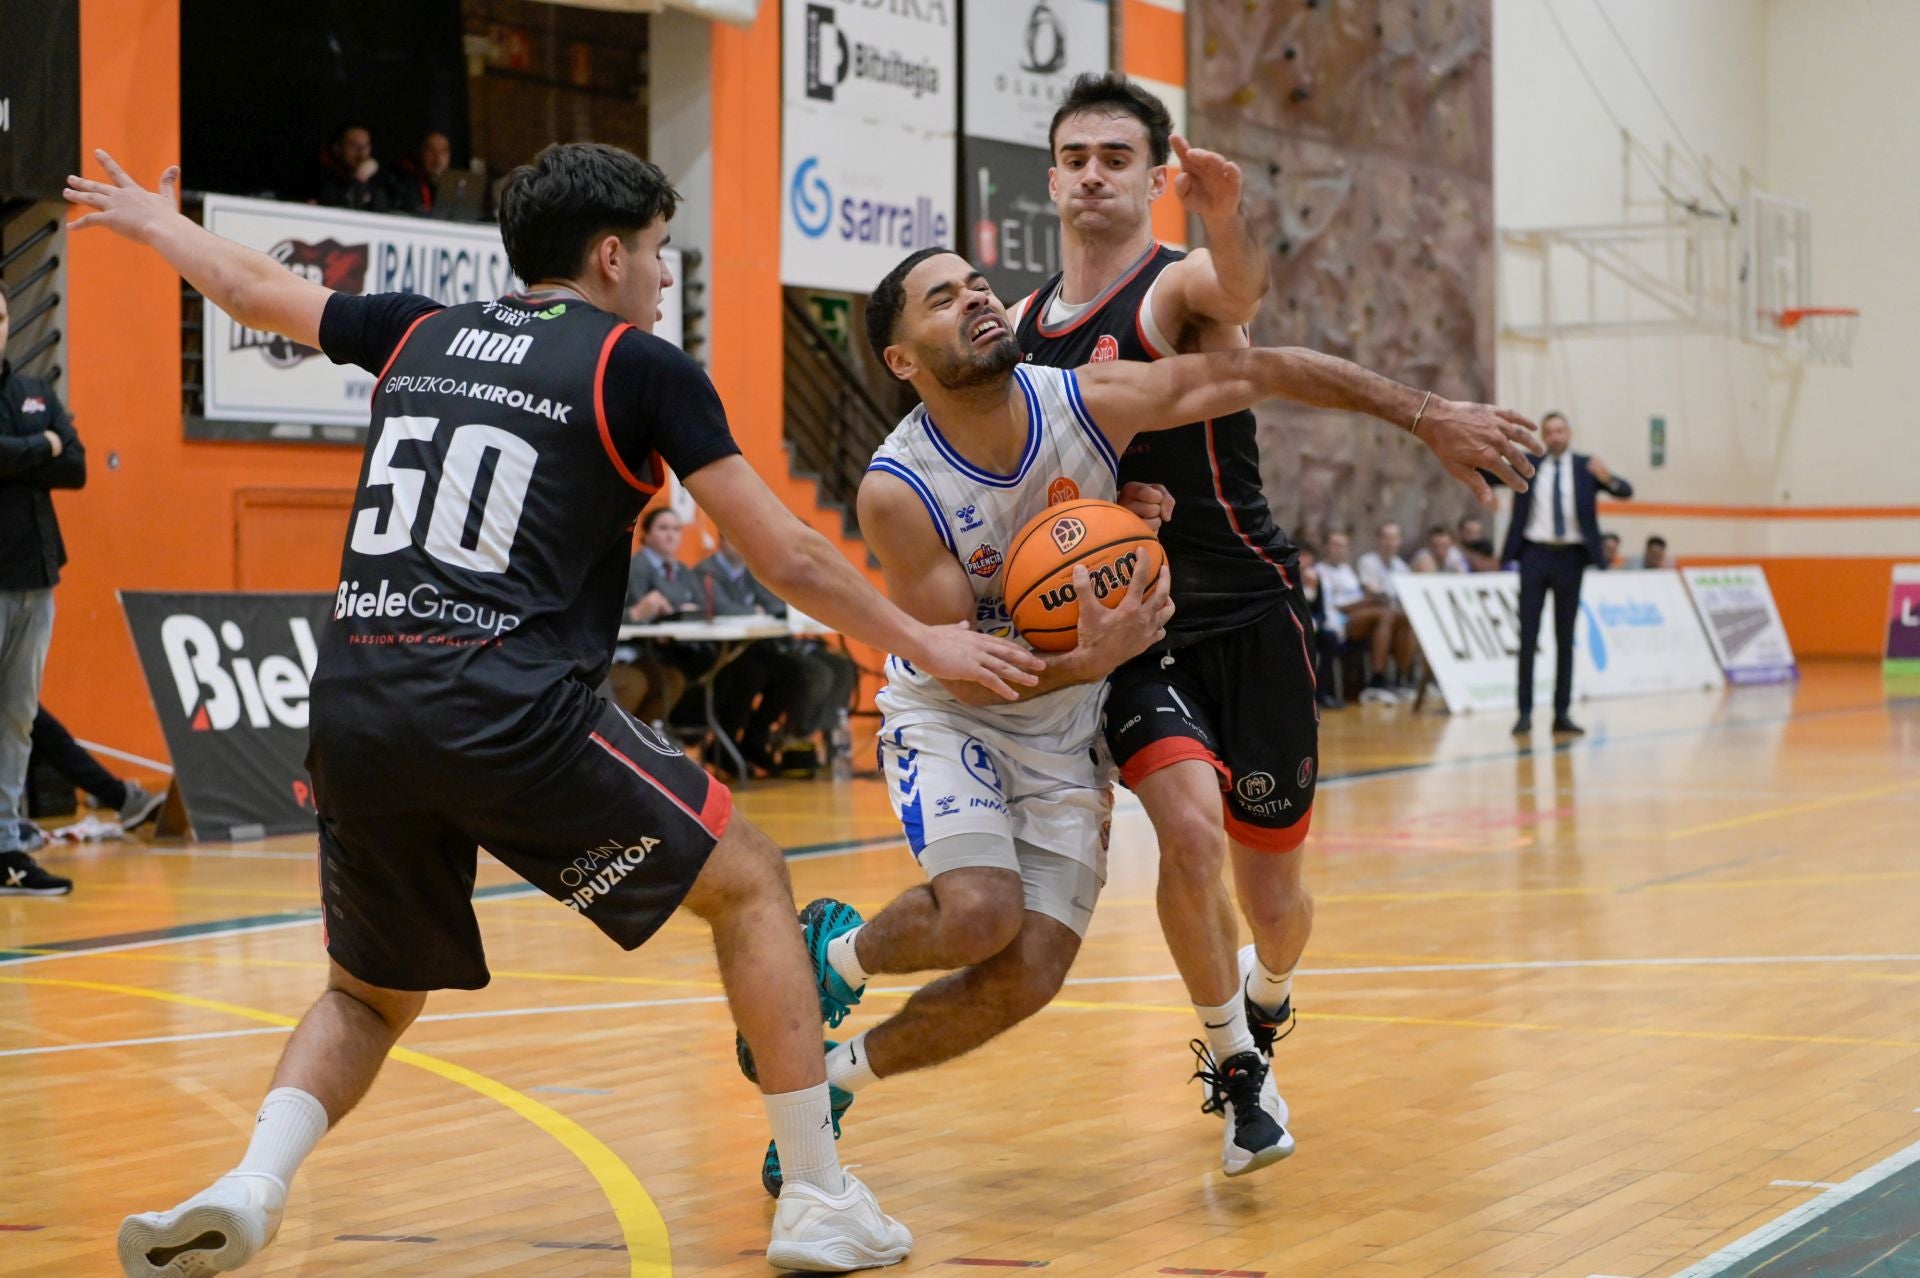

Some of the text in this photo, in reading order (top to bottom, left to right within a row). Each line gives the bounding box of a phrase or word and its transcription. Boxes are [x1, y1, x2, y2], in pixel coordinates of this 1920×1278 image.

[841, 196, 947, 250] sarralle
[445, 328, 534, 365] INDA
[351, 415, 539, 574] 50
[967, 552, 1003, 573] PALENCIA
[1039, 552, 1137, 611] Wilon
[349, 633, 394, 646] PASSION
[398, 635, 422, 644] FOR
[161, 614, 318, 730] Biel
[560, 838, 624, 887] ORAIN
